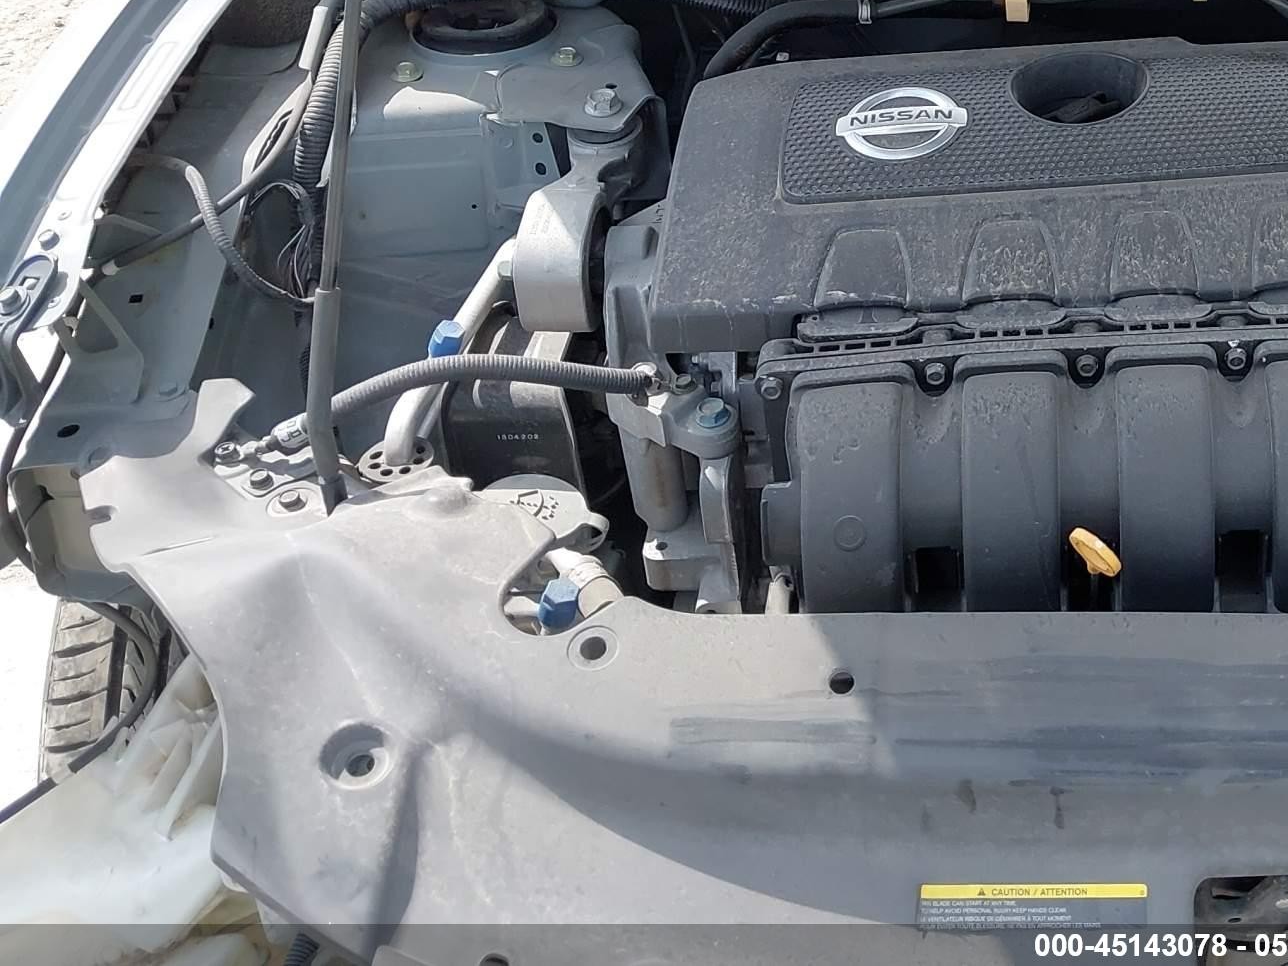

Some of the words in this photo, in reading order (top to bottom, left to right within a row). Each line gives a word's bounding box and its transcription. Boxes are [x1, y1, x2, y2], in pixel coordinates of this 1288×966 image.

[850, 109, 953, 127] NISSAN
[991, 888, 1031, 896] CAUTION
[1040, 888, 1088, 896] ATTENTION
